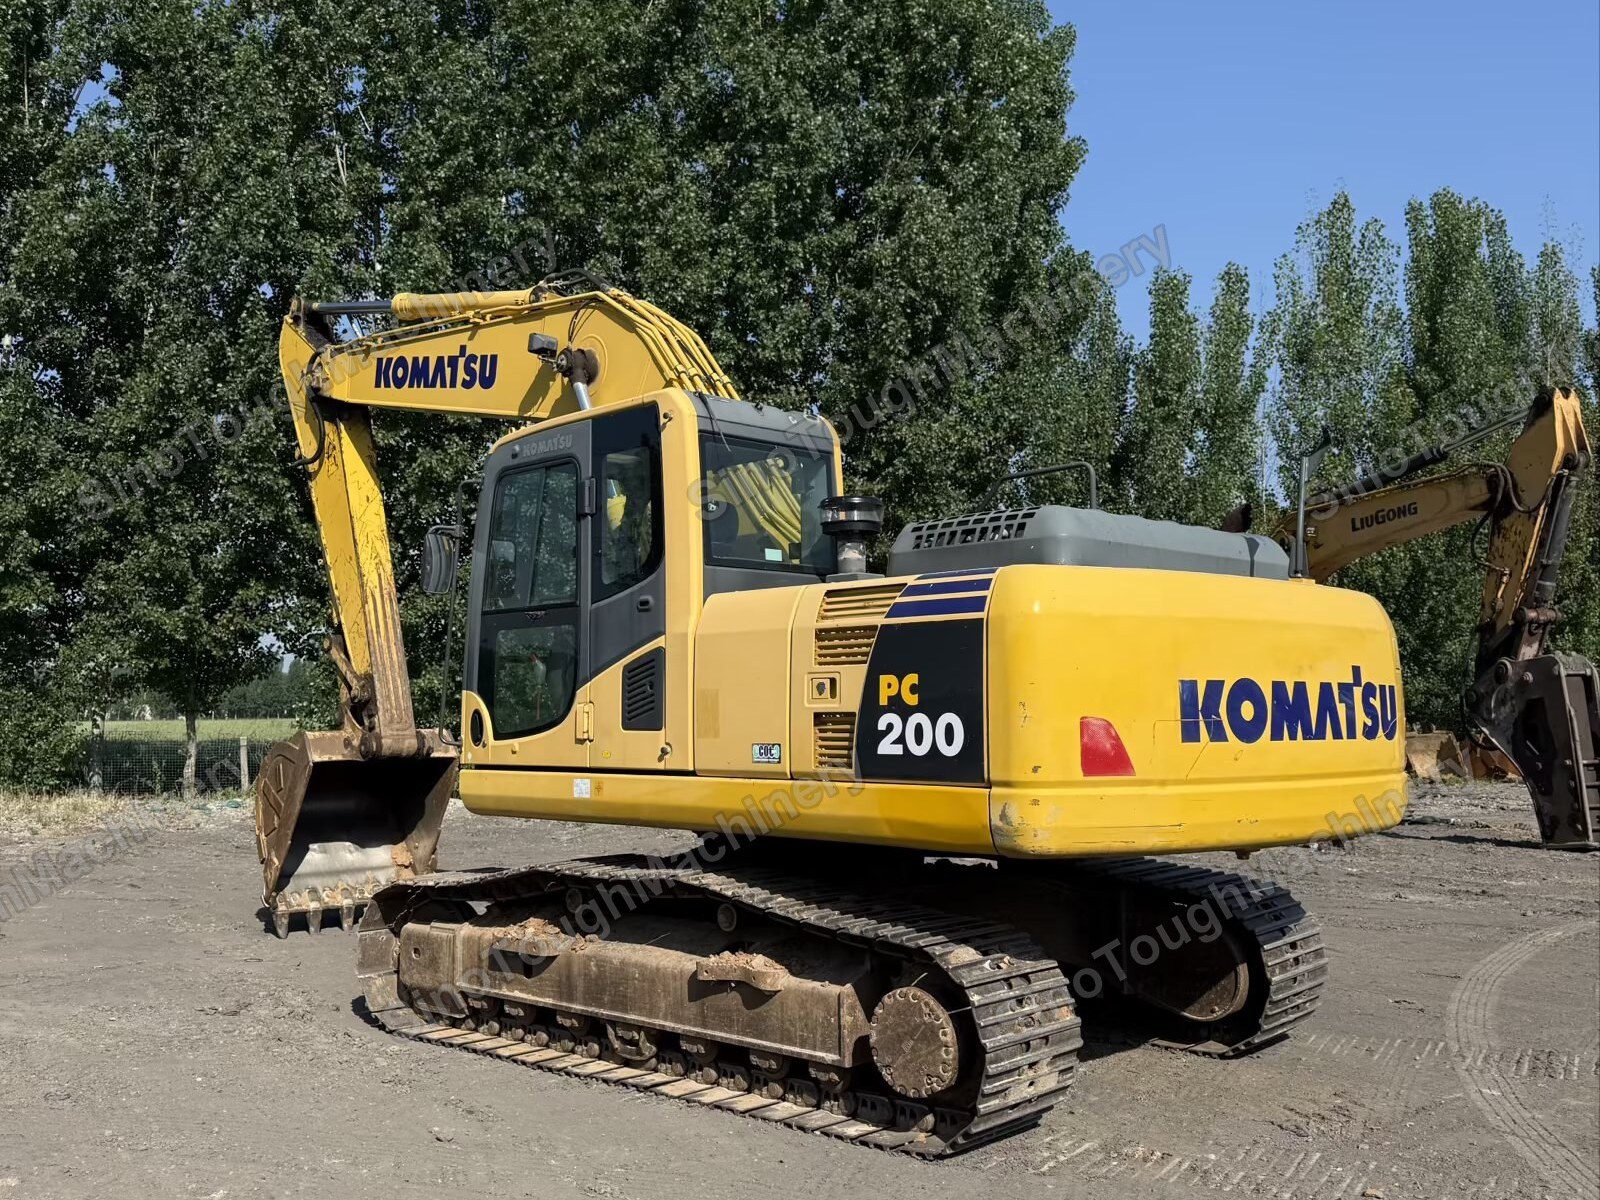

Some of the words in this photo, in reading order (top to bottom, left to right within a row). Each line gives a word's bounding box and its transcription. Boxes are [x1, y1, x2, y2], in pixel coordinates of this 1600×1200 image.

[374, 344, 498, 390] KOMATSU
[522, 434, 573, 457] KOMATSU
[879, 673, 919, 705] PC
[1178, 665, 1398, 744] KOMATSU
[877, 712, 965, 757] 200
